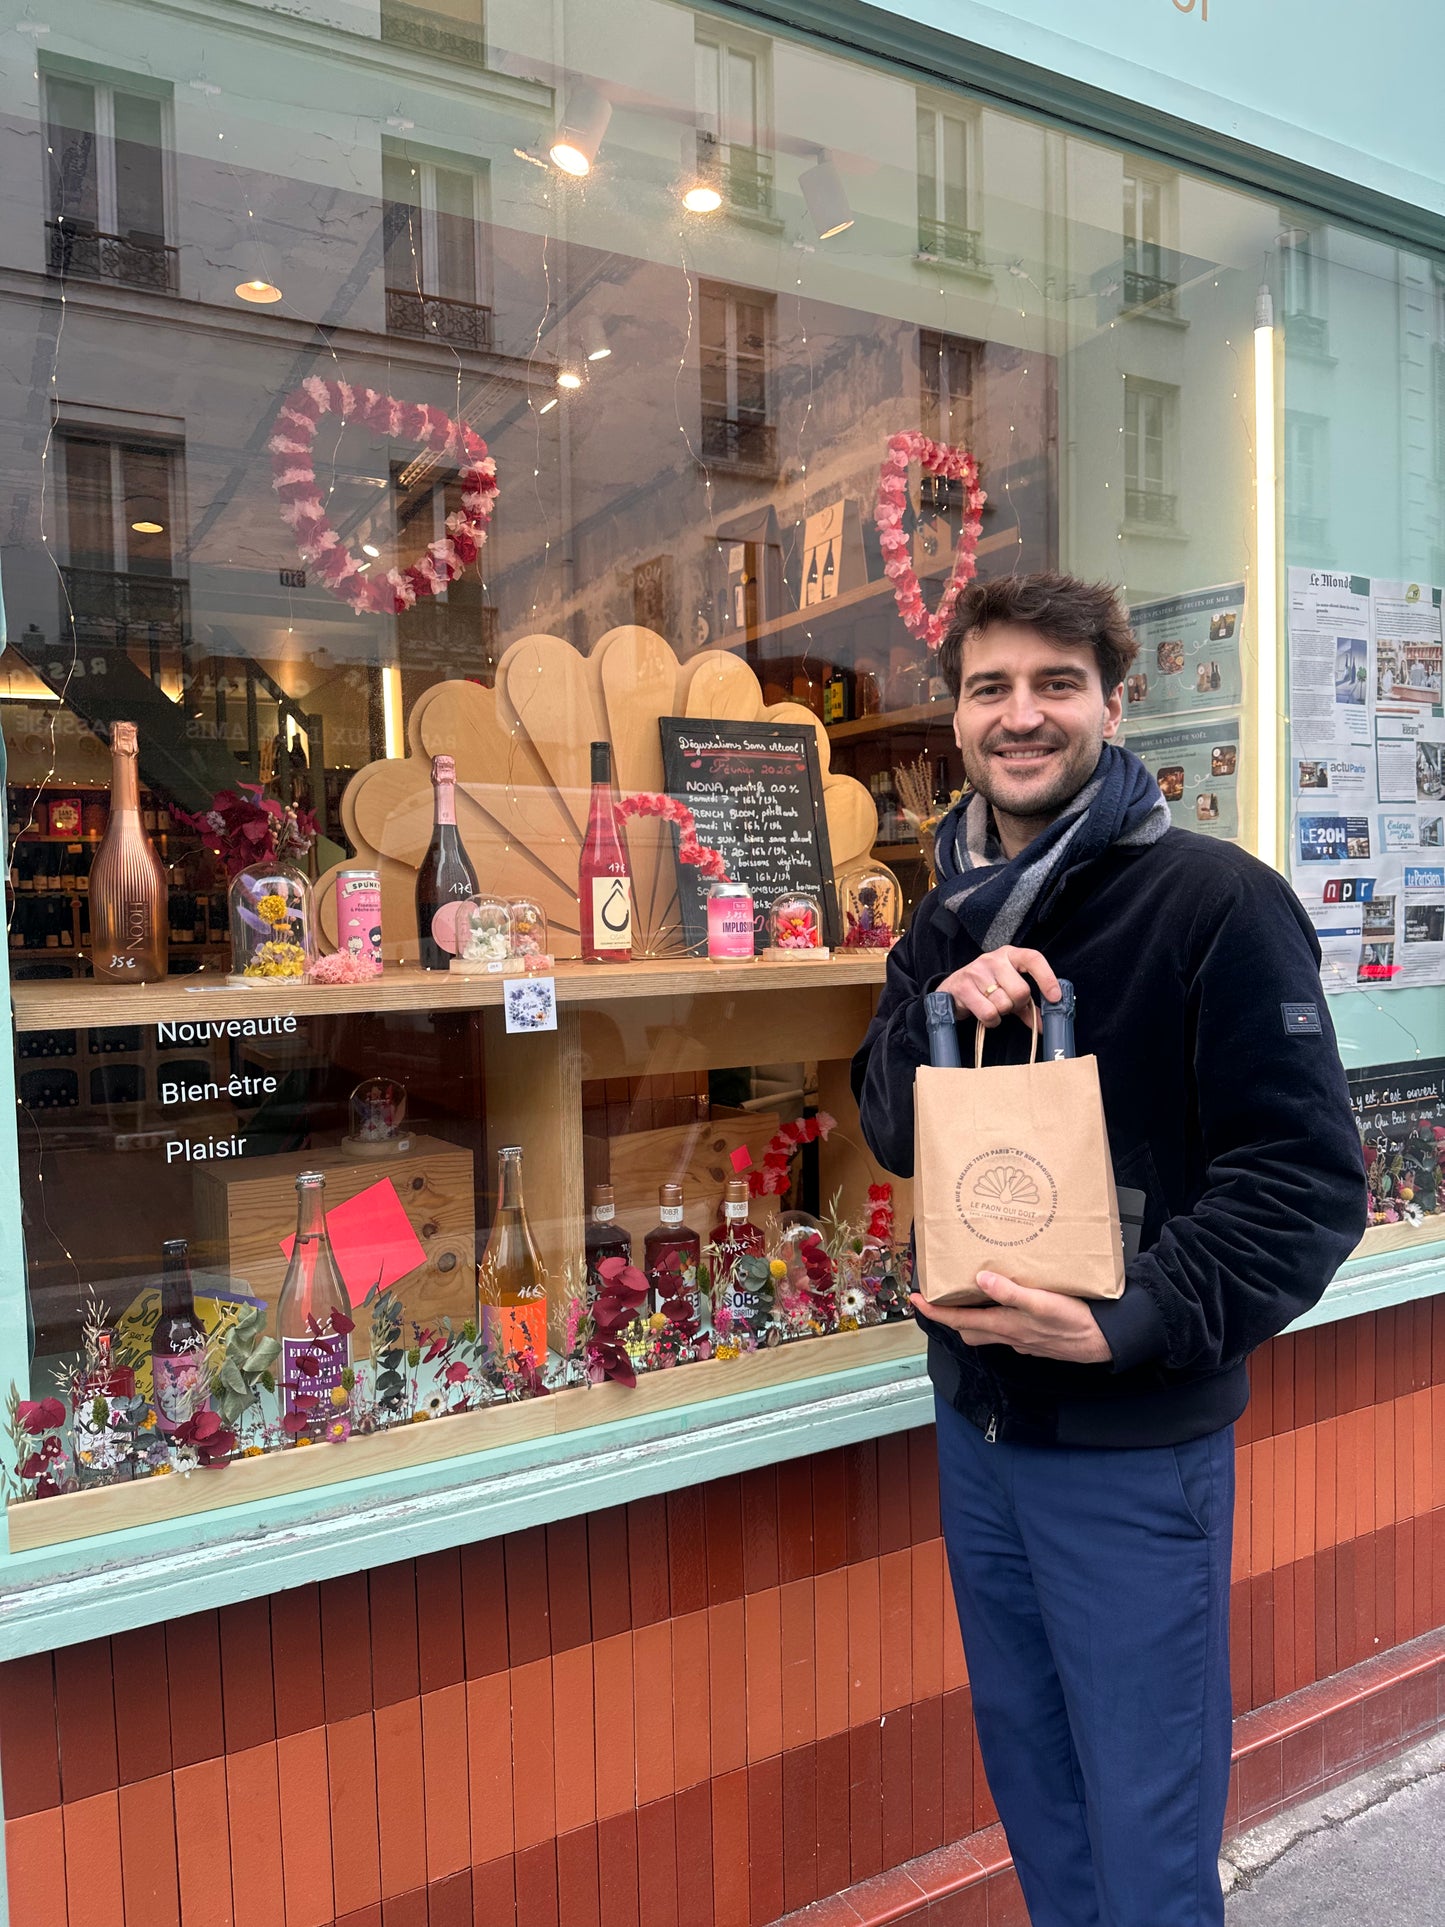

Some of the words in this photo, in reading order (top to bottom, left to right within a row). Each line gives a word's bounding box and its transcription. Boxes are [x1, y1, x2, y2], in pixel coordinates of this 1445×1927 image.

[1309, 573, 1320, 587] Le
[679, 736, 741, 755] Dégustations
[743, 740, 766, 751] Sans
[761, 764, 792, 775] 2026
[694, 821, 718, 830] amedi
[723, 821, 732, 831] 14
[695, 834, 713, 844] INK
[769, 834, 786, 843] sans
[608, 862, 626, 873] 17€
[1414, 869, 1441, 887] Parisien
[449, 882, 473, 894] 17€
[752, 885, 788, 895] OMBUCHA
[1327, 882, 1369, 901] npr
[126, 902, 144, 950] NOOH
[157, 1011, 297, 1043] Nouveauté
[162, 1074, 277, 1105] Bien-être
[1407, 1083, 1438, 1099] ouvert
[166, 1135, 247, 1163] Plaisir
[990, 1148, 1009, 1156] PARIS
[970, 1201, 979, 1209] LE
[981, 1202, 1000, 1212] PAON
[1003, 1206, 1017, 1215] QUI
